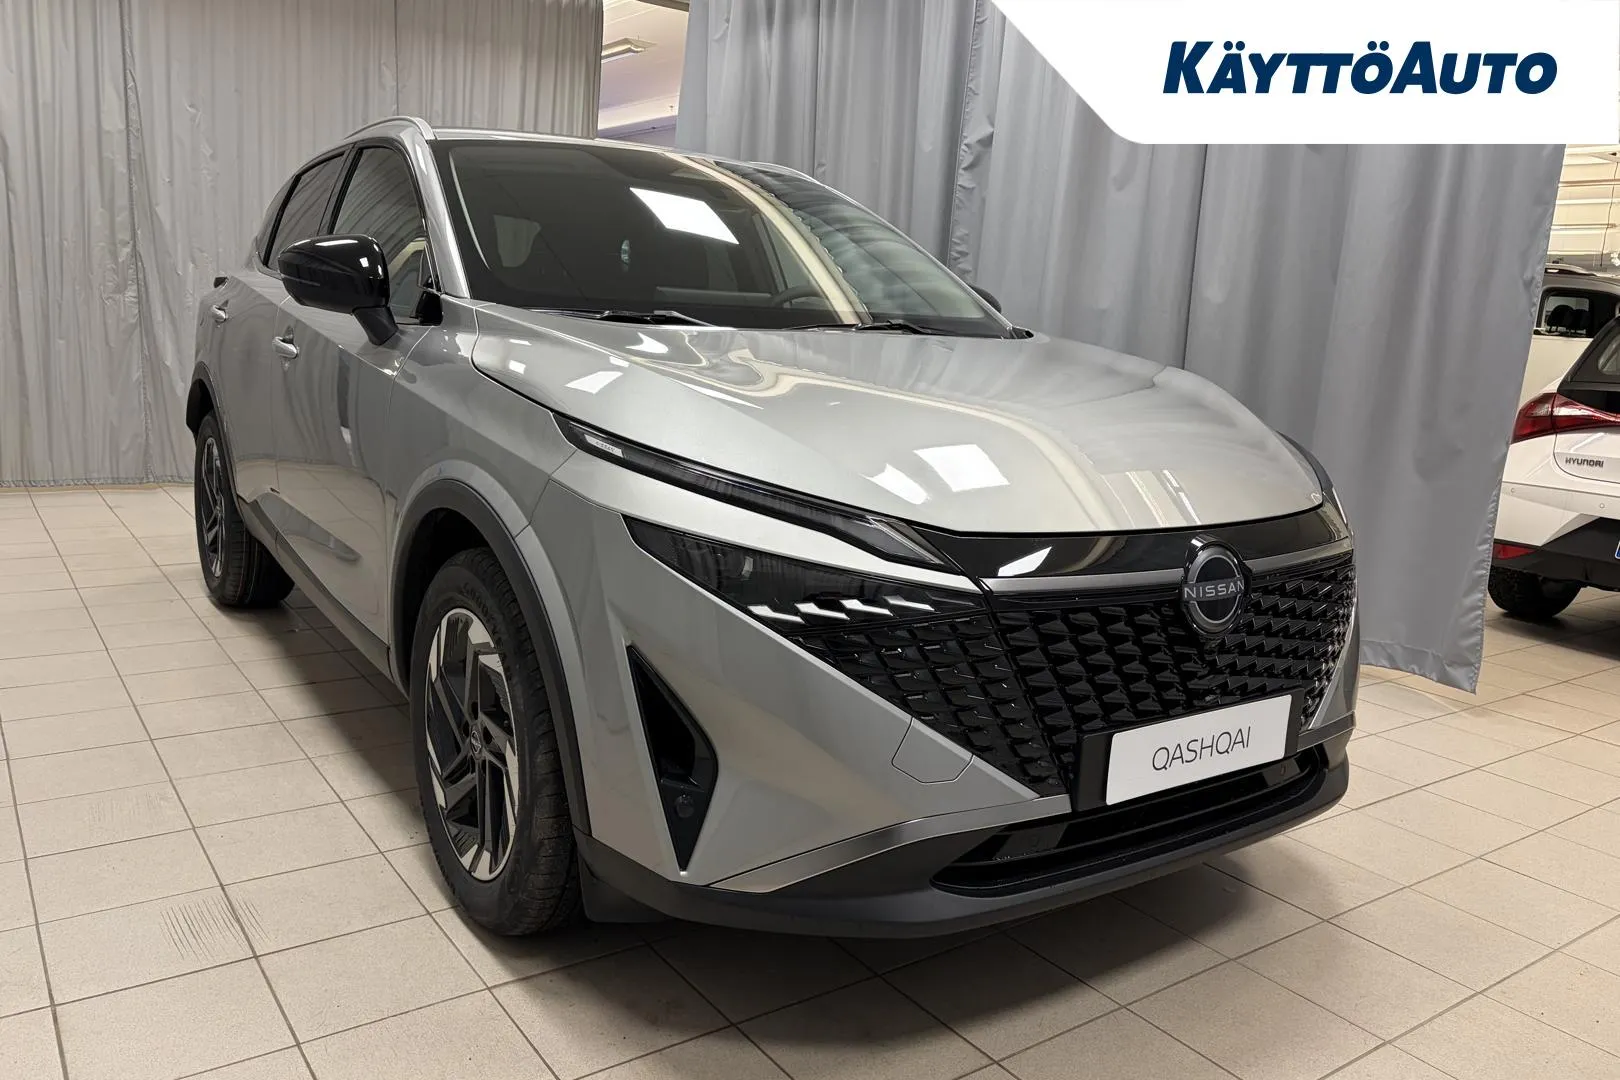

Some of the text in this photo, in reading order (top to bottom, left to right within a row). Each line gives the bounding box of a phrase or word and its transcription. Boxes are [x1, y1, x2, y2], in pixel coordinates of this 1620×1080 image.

[1565, 457, 1604, 468] HYUNDAI
[1184, 580, 1244, 598] NISSAN
[1152, 726, 1251, 771] QASHQAI
